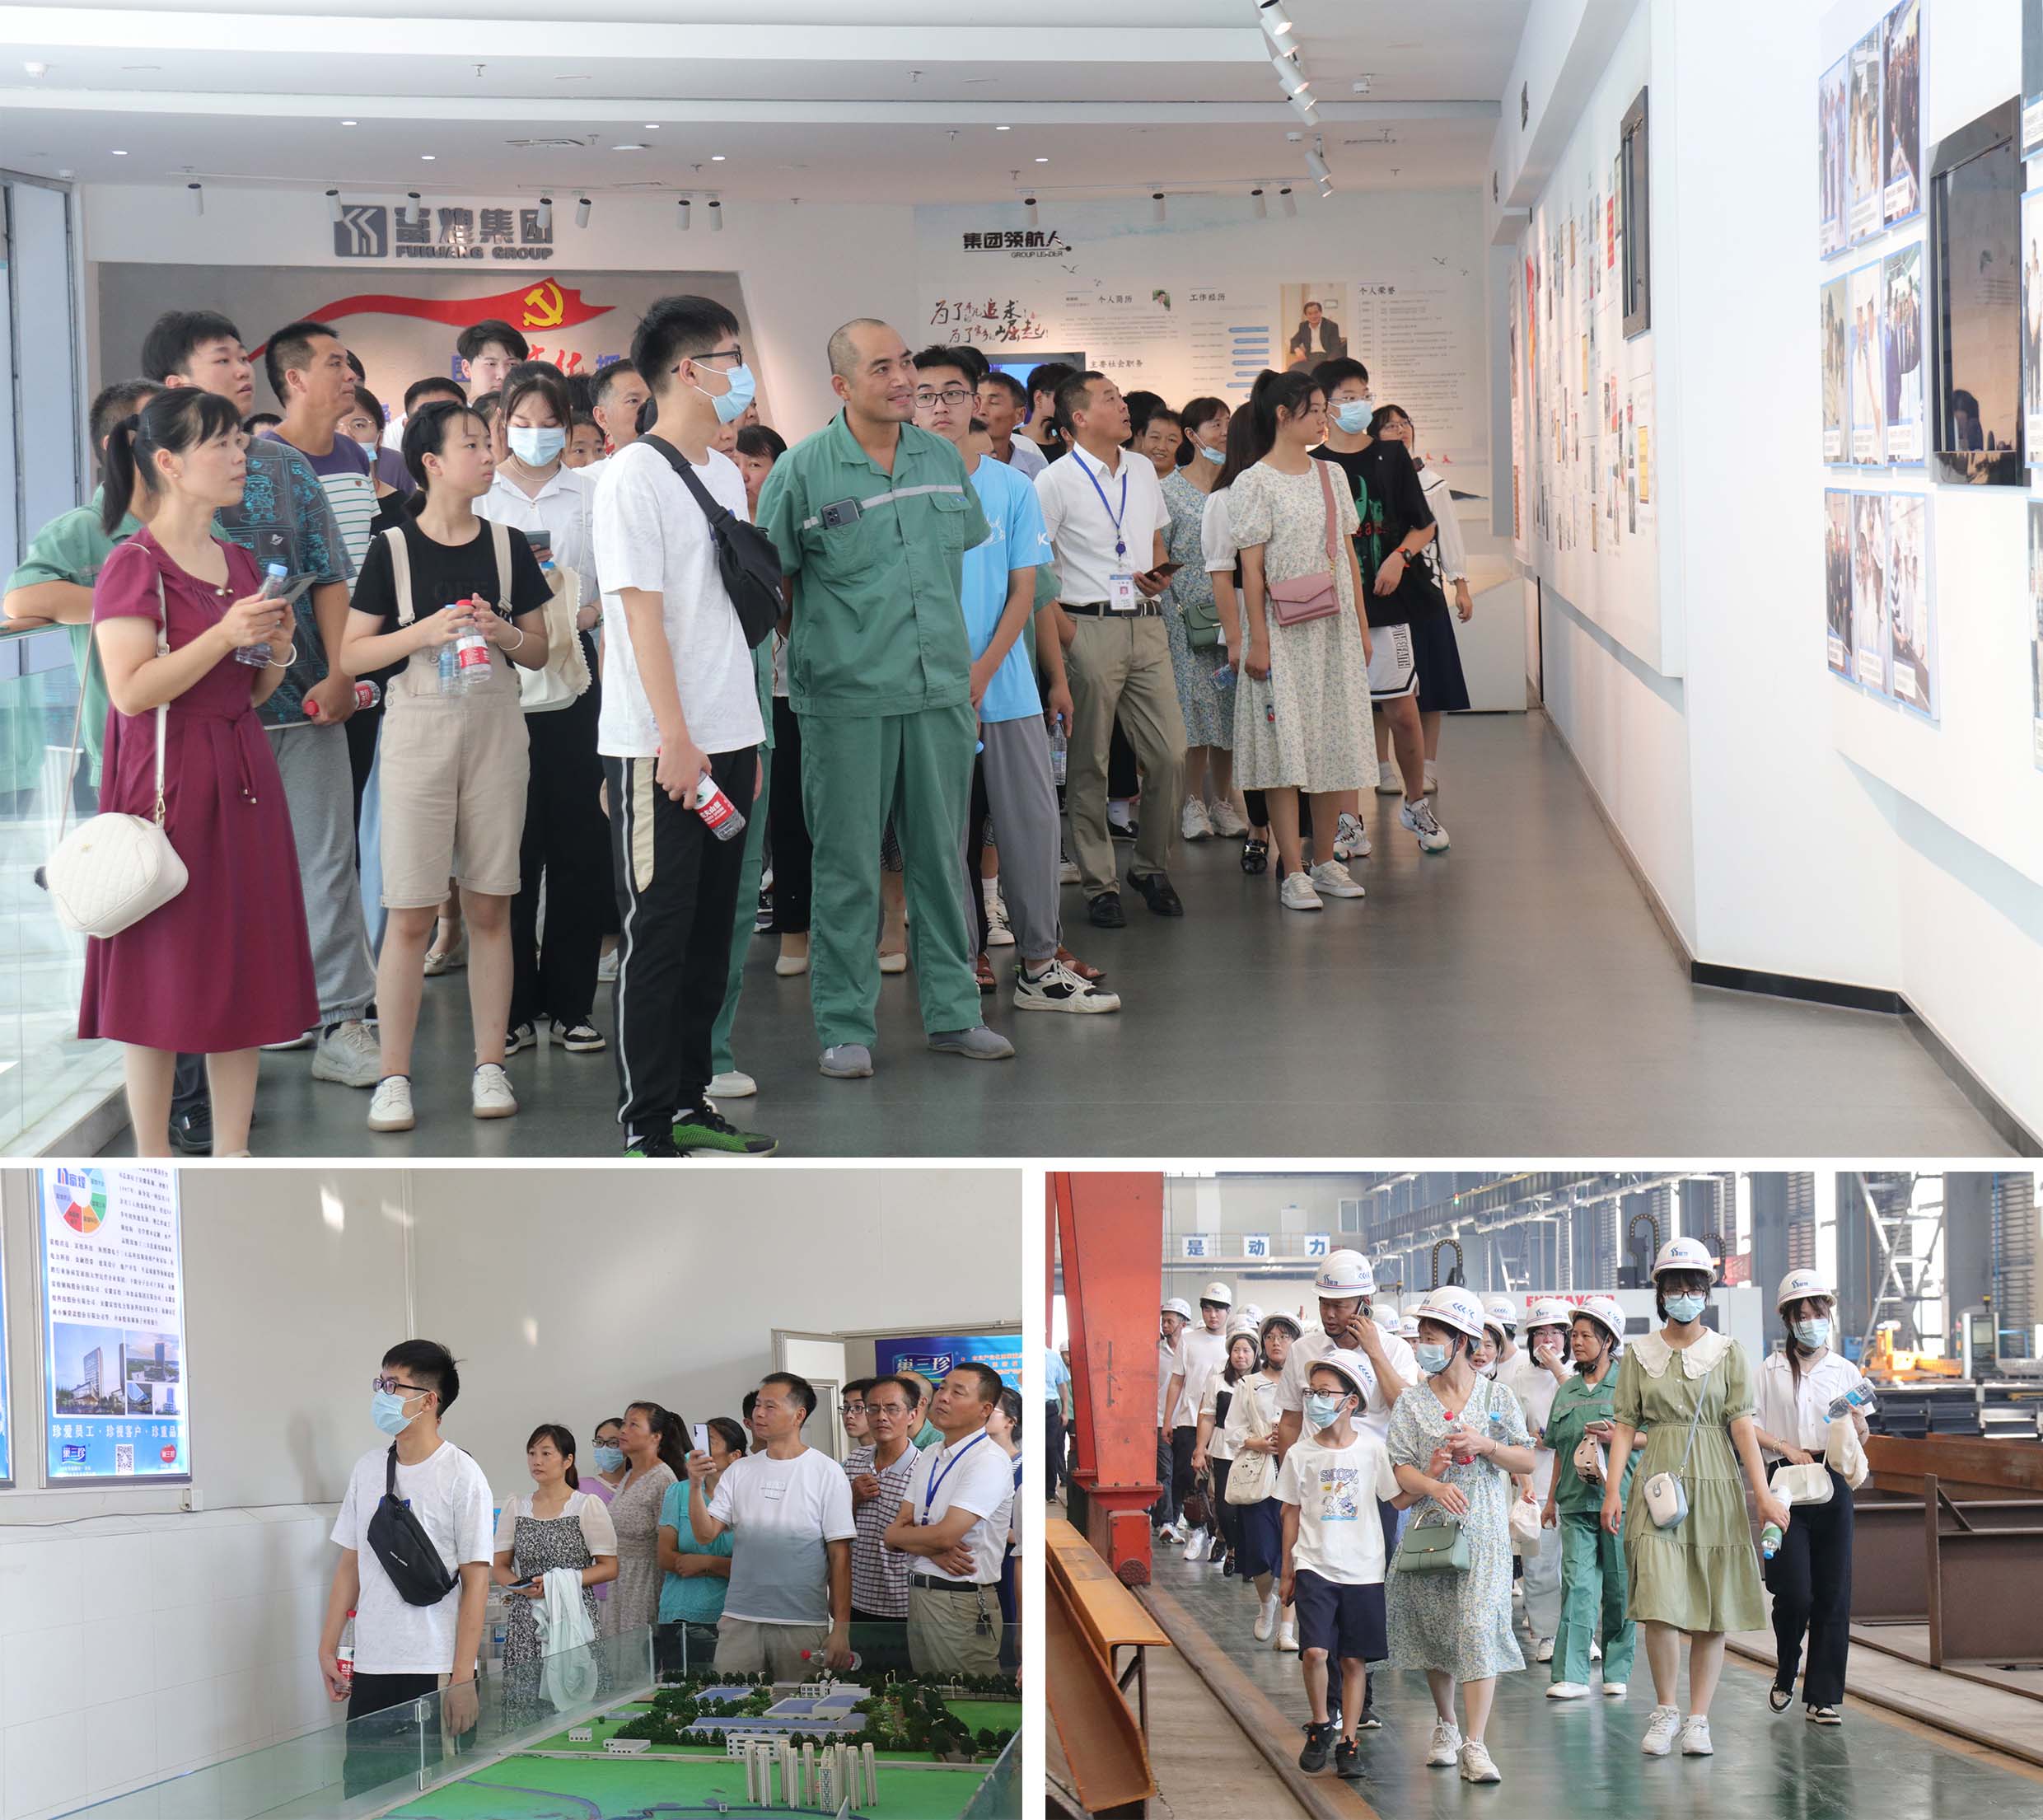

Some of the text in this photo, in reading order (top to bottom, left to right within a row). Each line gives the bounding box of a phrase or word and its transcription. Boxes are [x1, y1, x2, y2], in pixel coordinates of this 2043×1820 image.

[963, 231, 1064, 249] 集团领航人
[492, 247, 554, 260] GROUP
